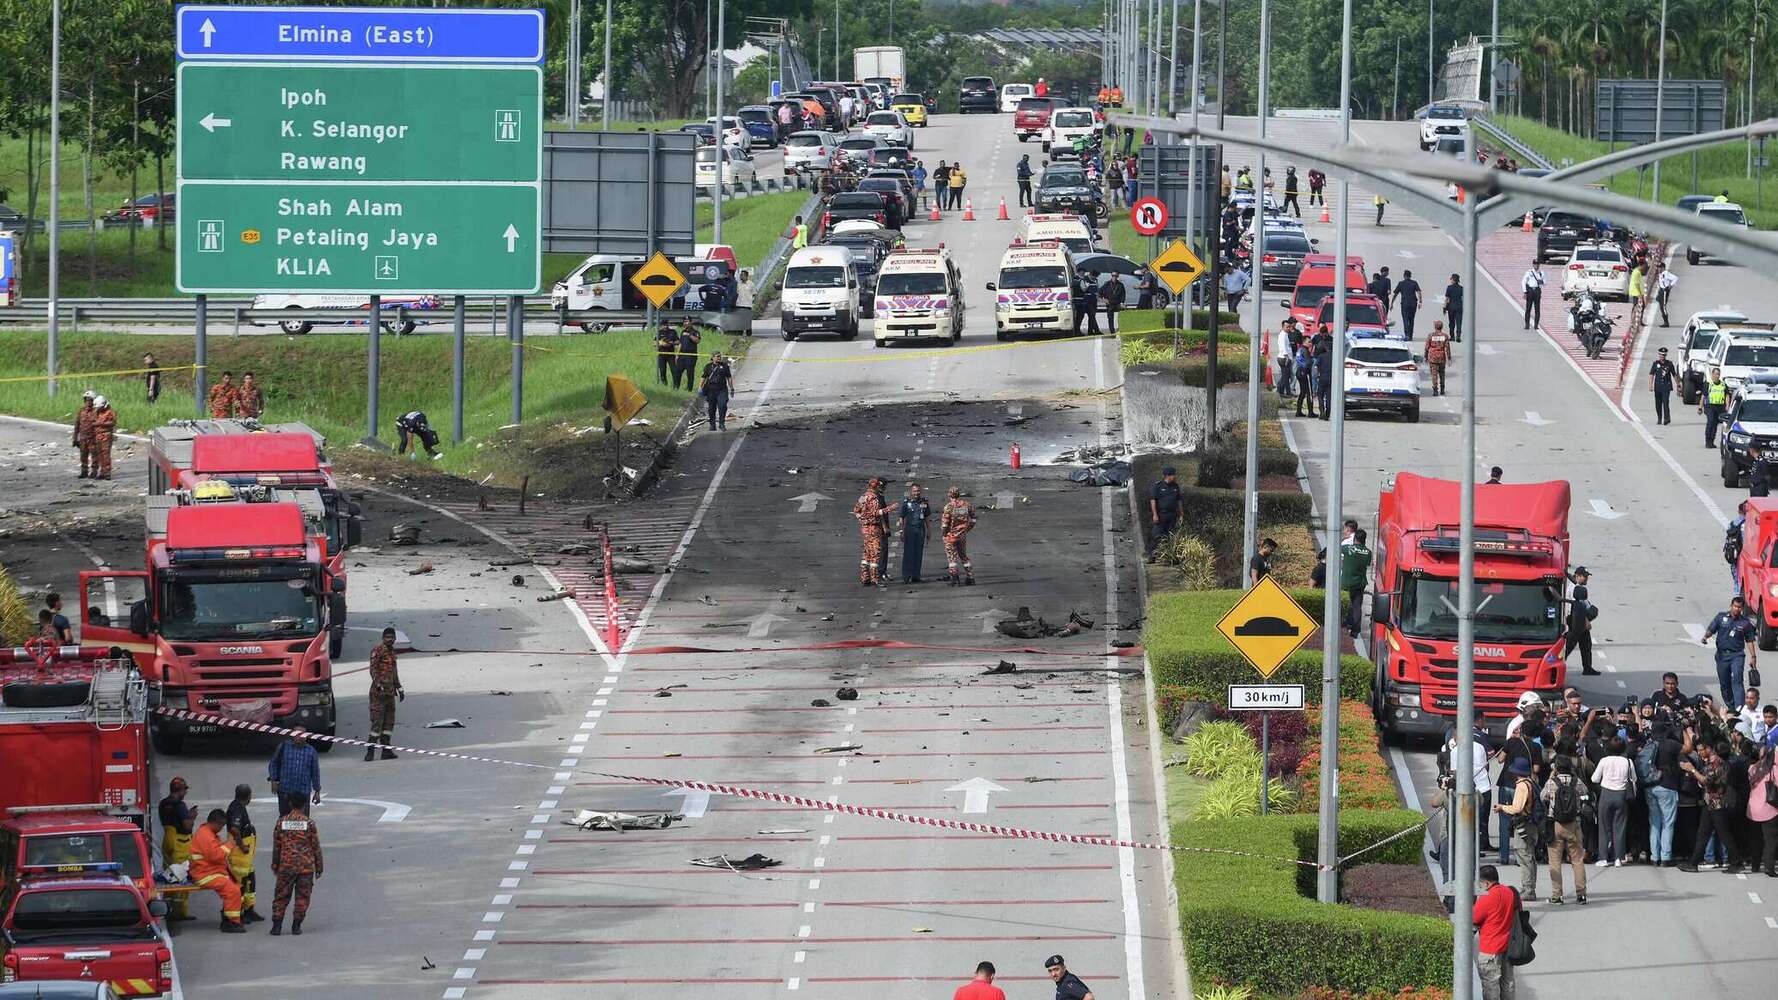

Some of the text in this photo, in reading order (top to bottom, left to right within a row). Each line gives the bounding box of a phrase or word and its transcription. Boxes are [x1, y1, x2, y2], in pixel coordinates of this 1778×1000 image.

[279, 25, 433, 47] Elmina (East)
[281, 88, 326, 109] Ipoh
[281, 120, 409, 143] K. Selangor
[281, 153, 366, 174] Rawang
[278, 199, 403, 216] Shah Alam
[278, 228, 438, 250] Petaling Jaya
[278, 257, 331, 276] KLIA
[220, 646, 263, 655] SCANIA
[1452, 647, 1506, 659] SANIA
[1245, 691, 1289, 704] 30km/j
[58, 865, 84, 873] BOMBA
